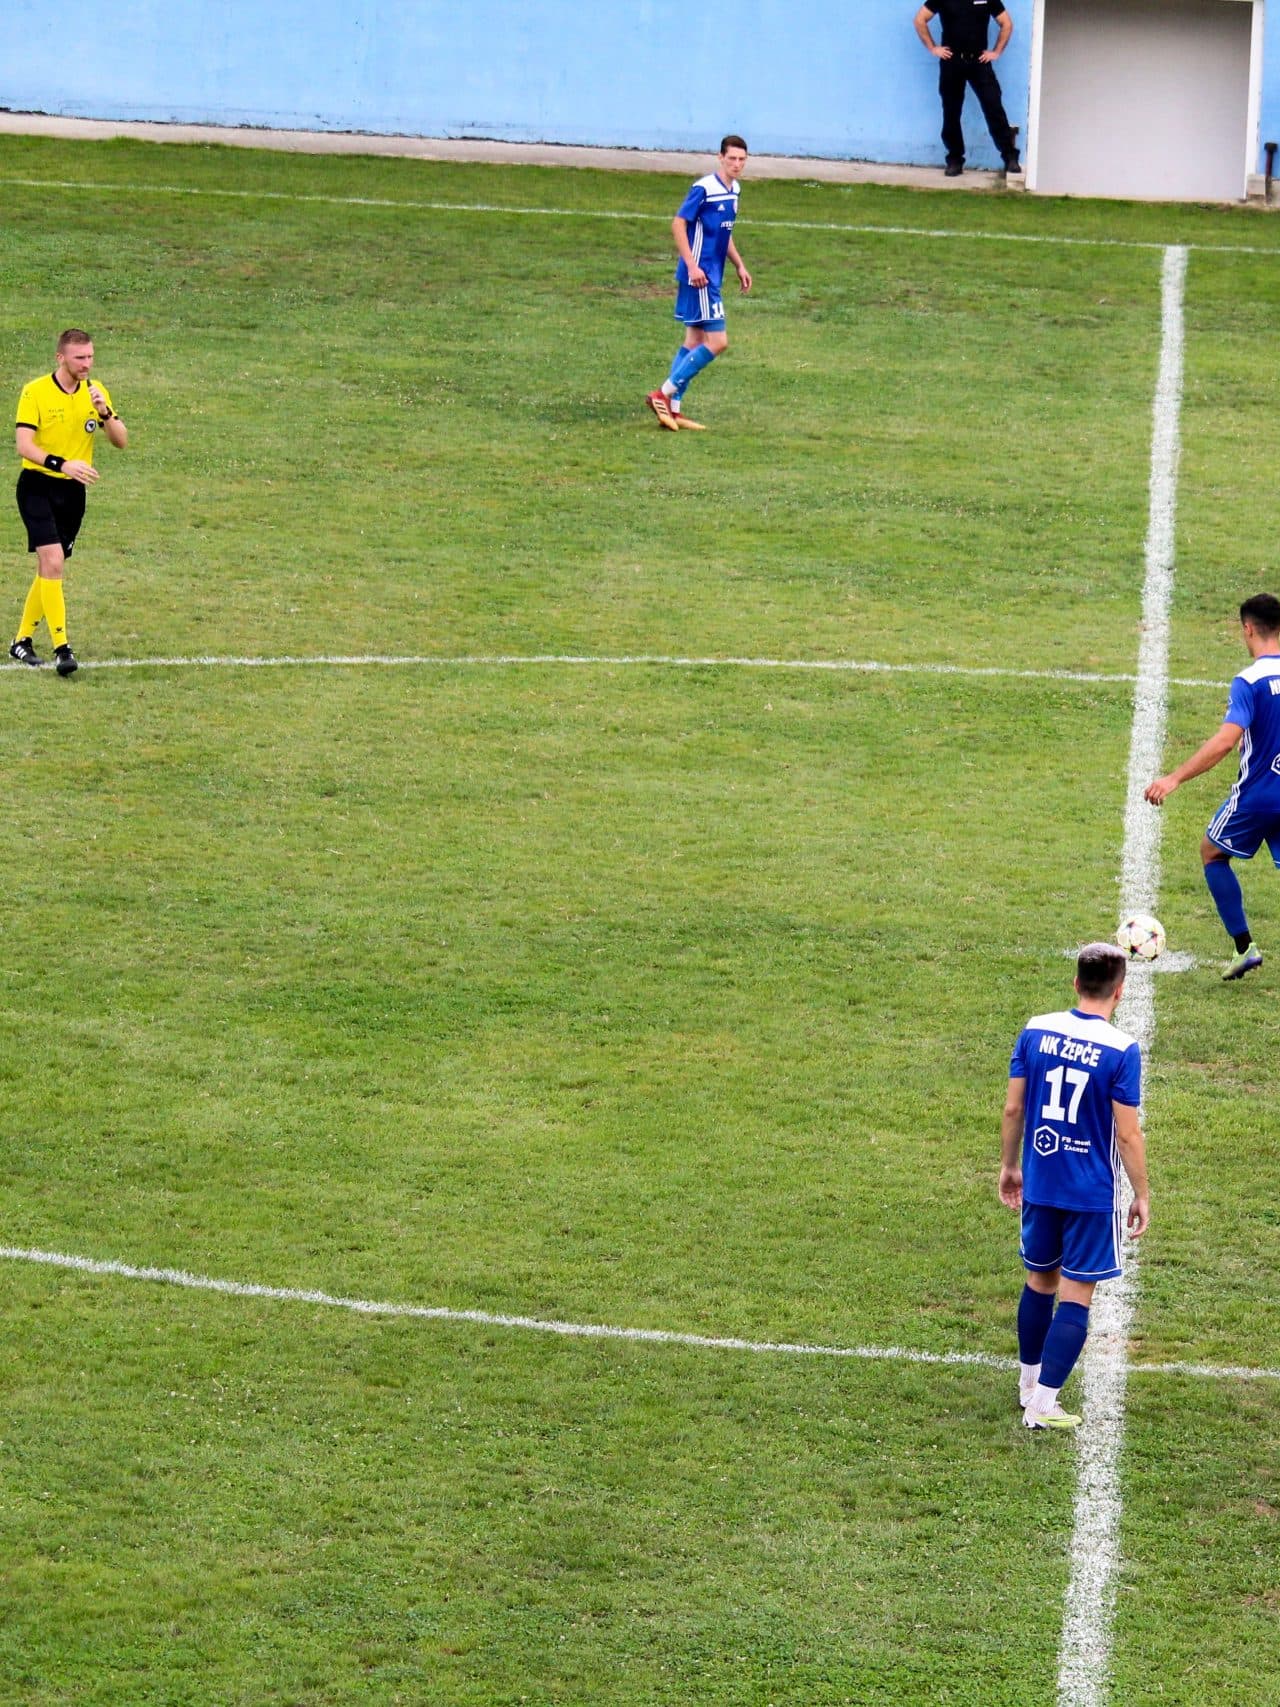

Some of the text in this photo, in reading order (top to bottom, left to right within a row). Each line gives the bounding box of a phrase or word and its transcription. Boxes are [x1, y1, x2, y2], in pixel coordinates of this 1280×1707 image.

[1039, 1034, 1102, 1067] NK ŽEPČE
[1041, 1065, 1090, 1124] 17
